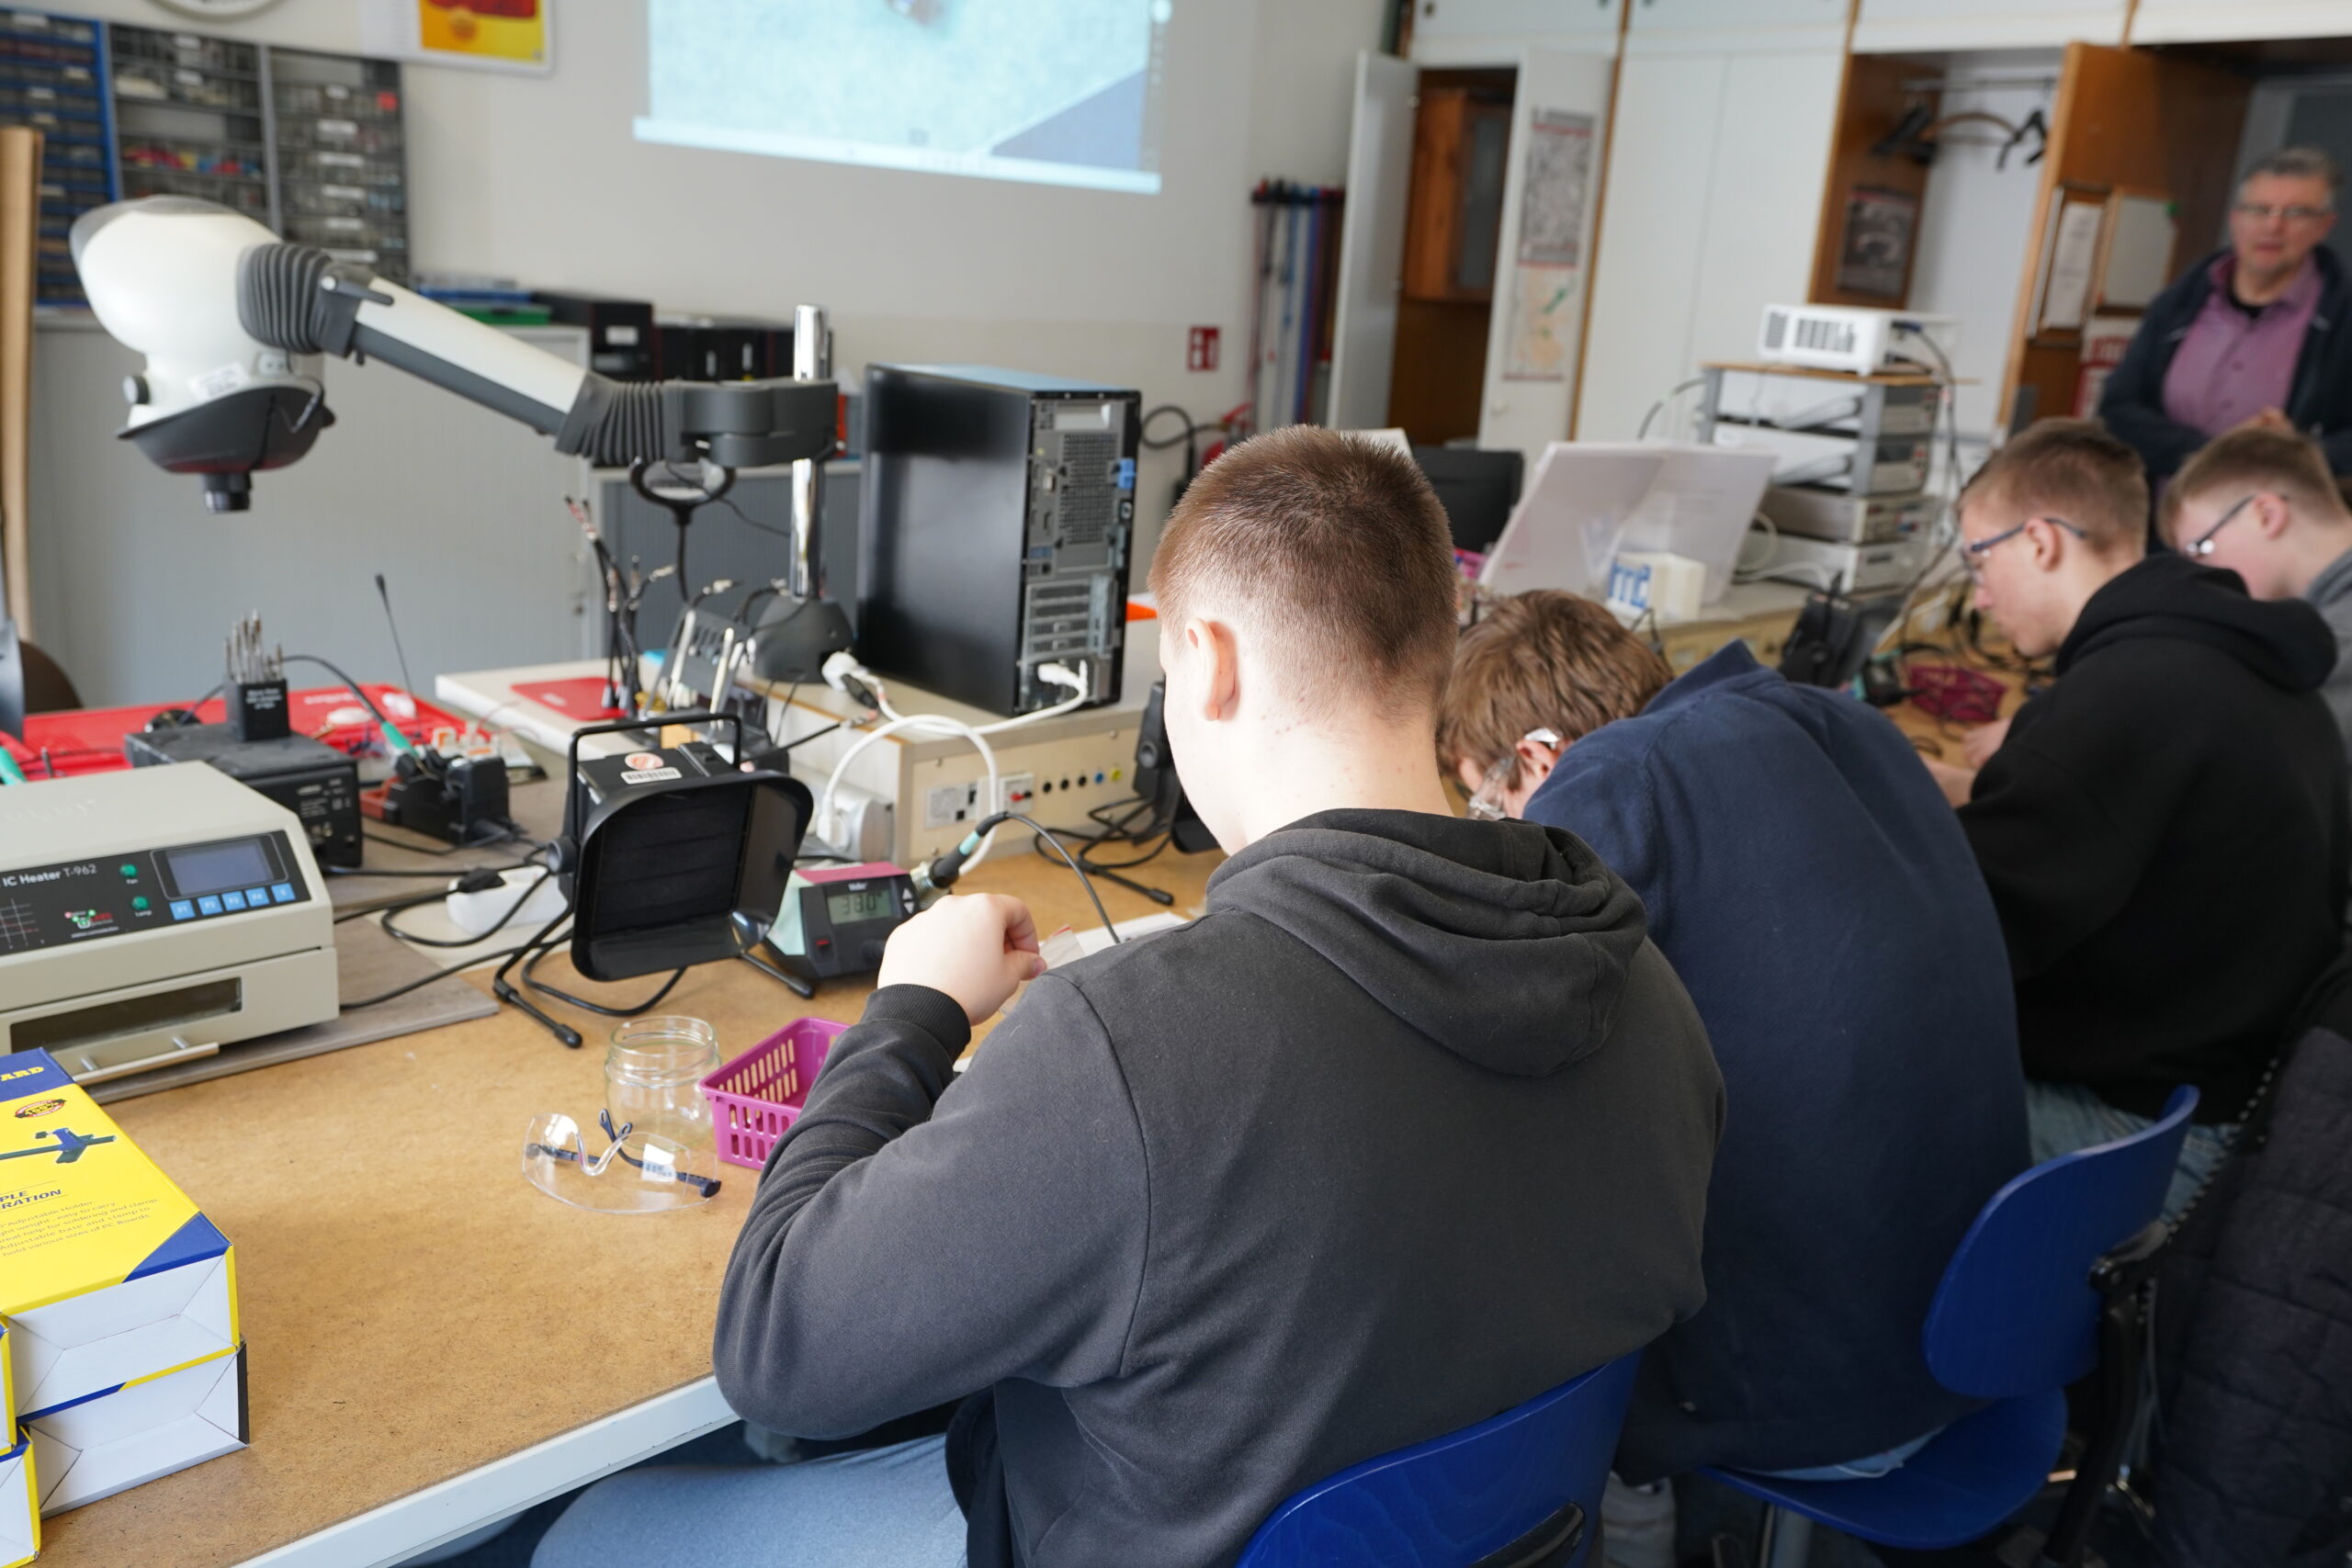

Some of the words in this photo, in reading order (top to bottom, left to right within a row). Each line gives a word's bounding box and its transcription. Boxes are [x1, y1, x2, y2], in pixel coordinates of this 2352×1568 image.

[3, 875, 17, 887] IC
[19, 871, 62, 885] Heater
[62, 863, 97, 878] T-962
